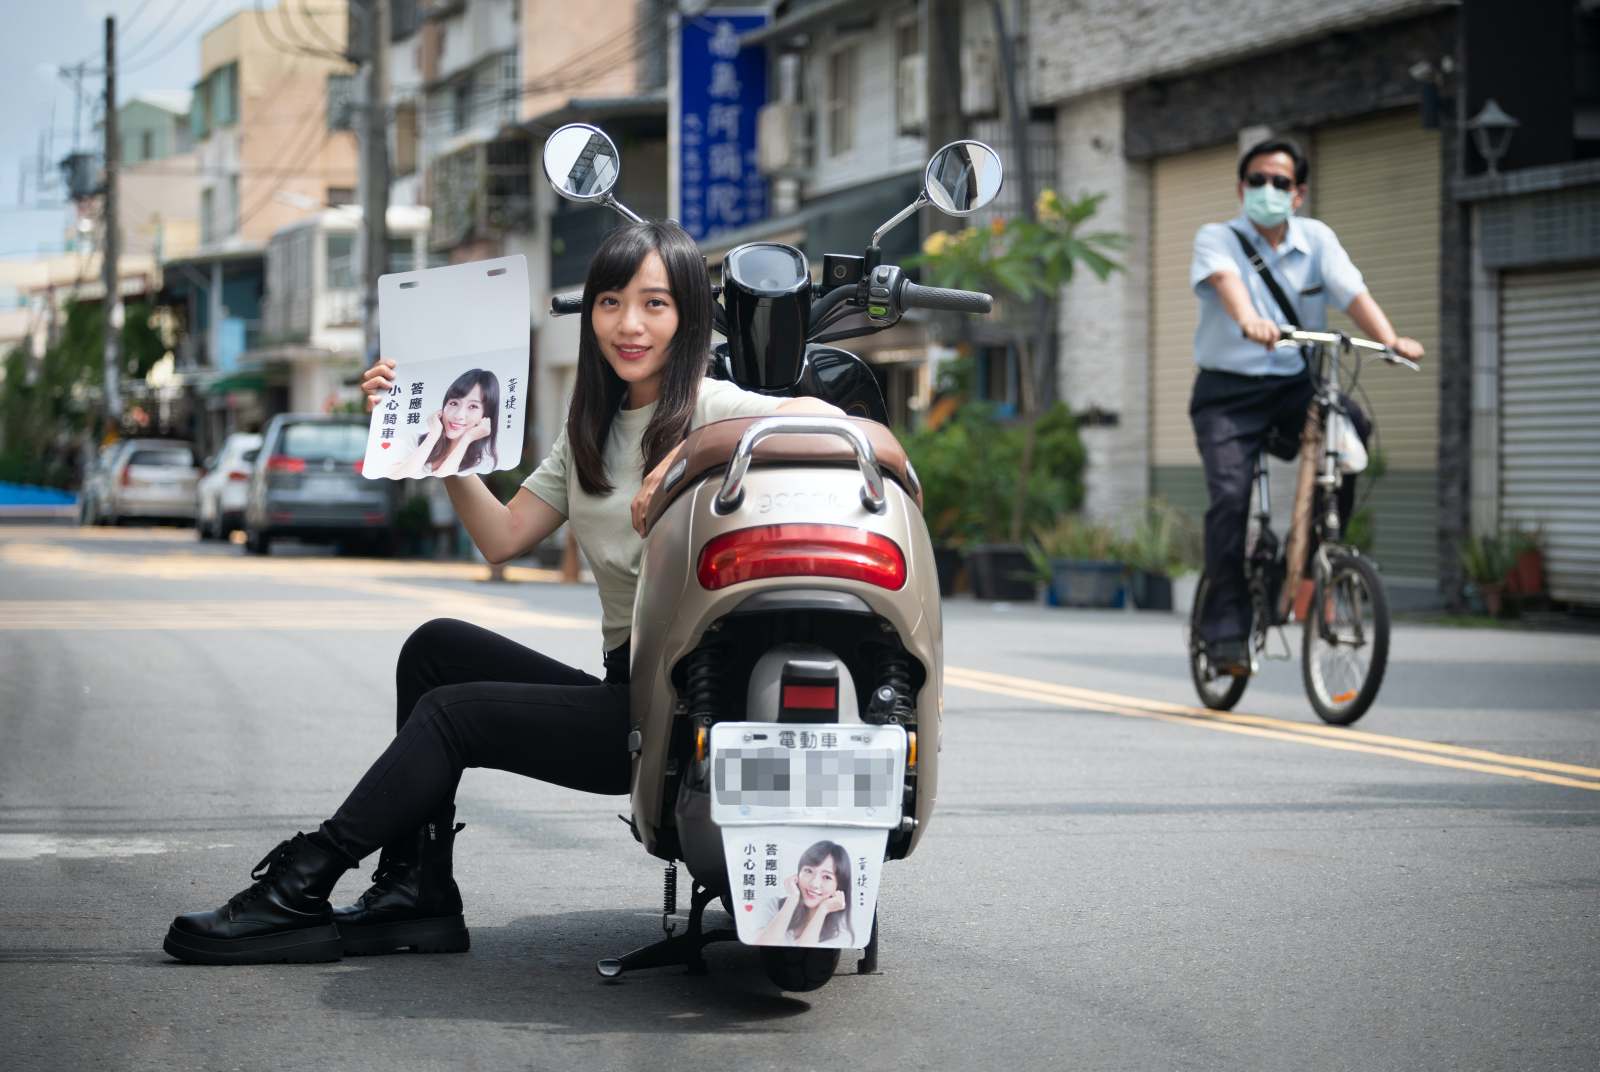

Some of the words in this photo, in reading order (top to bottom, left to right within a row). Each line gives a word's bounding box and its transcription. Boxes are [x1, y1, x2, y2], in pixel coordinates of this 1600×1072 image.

[380, 384, 402, 440] 小心騎車
[406, 382, 424, 425] 答應我
[778, 730, 838, 749] 電動車
[743, 843, 757, 901] 小心騎車
[764, 843, 778, 887] 答應我
